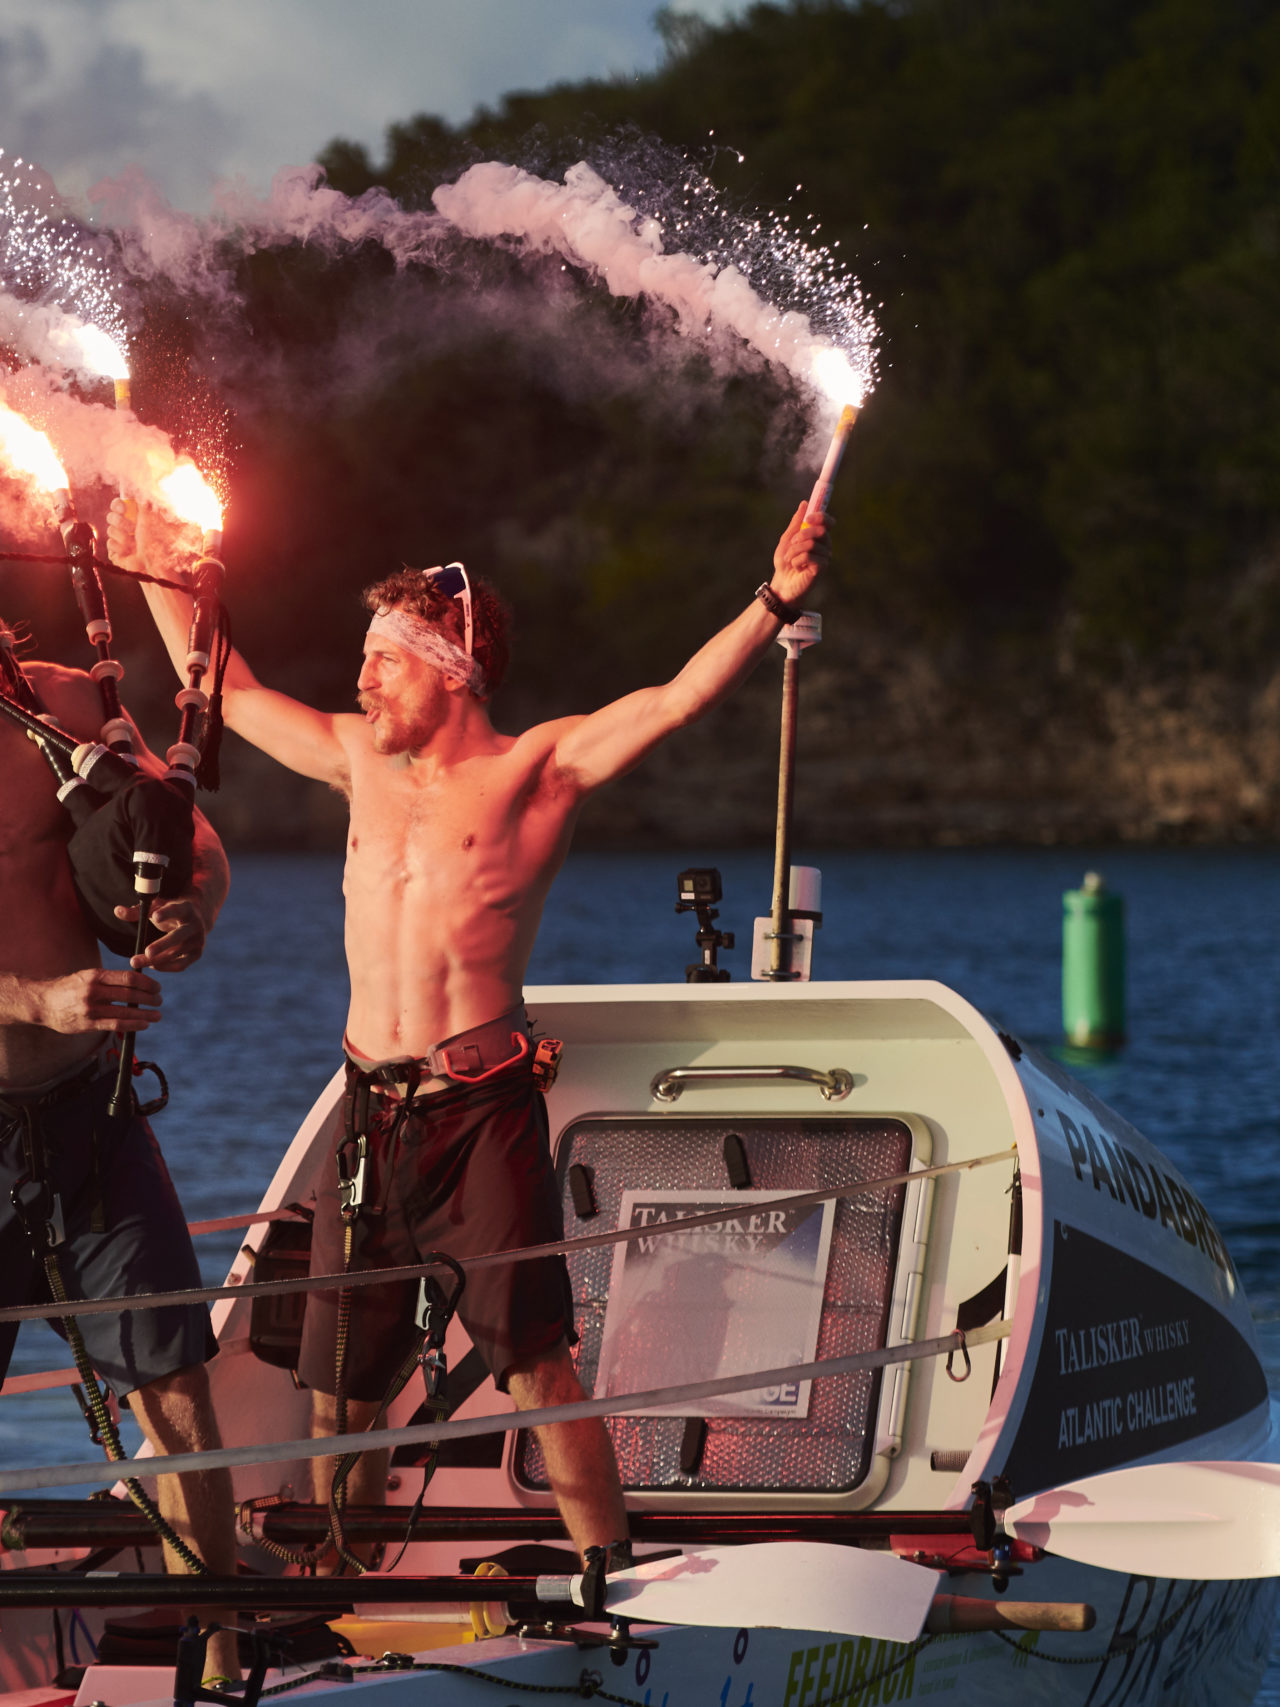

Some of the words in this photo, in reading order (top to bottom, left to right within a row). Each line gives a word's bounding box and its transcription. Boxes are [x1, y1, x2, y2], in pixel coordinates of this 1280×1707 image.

[638, 1233, 764, 1254] WHISKY
[1055, 1316, 1144, 1376] TALISKER
[1143, 1319, 1191, 1353] WHISKY
[1058, 1396, 1124, 1449] ATLANTIC
[1126, 1376, 1197, 1432] CHALLENGE
[783, 1636, 917, 1707] FEEDBACK
